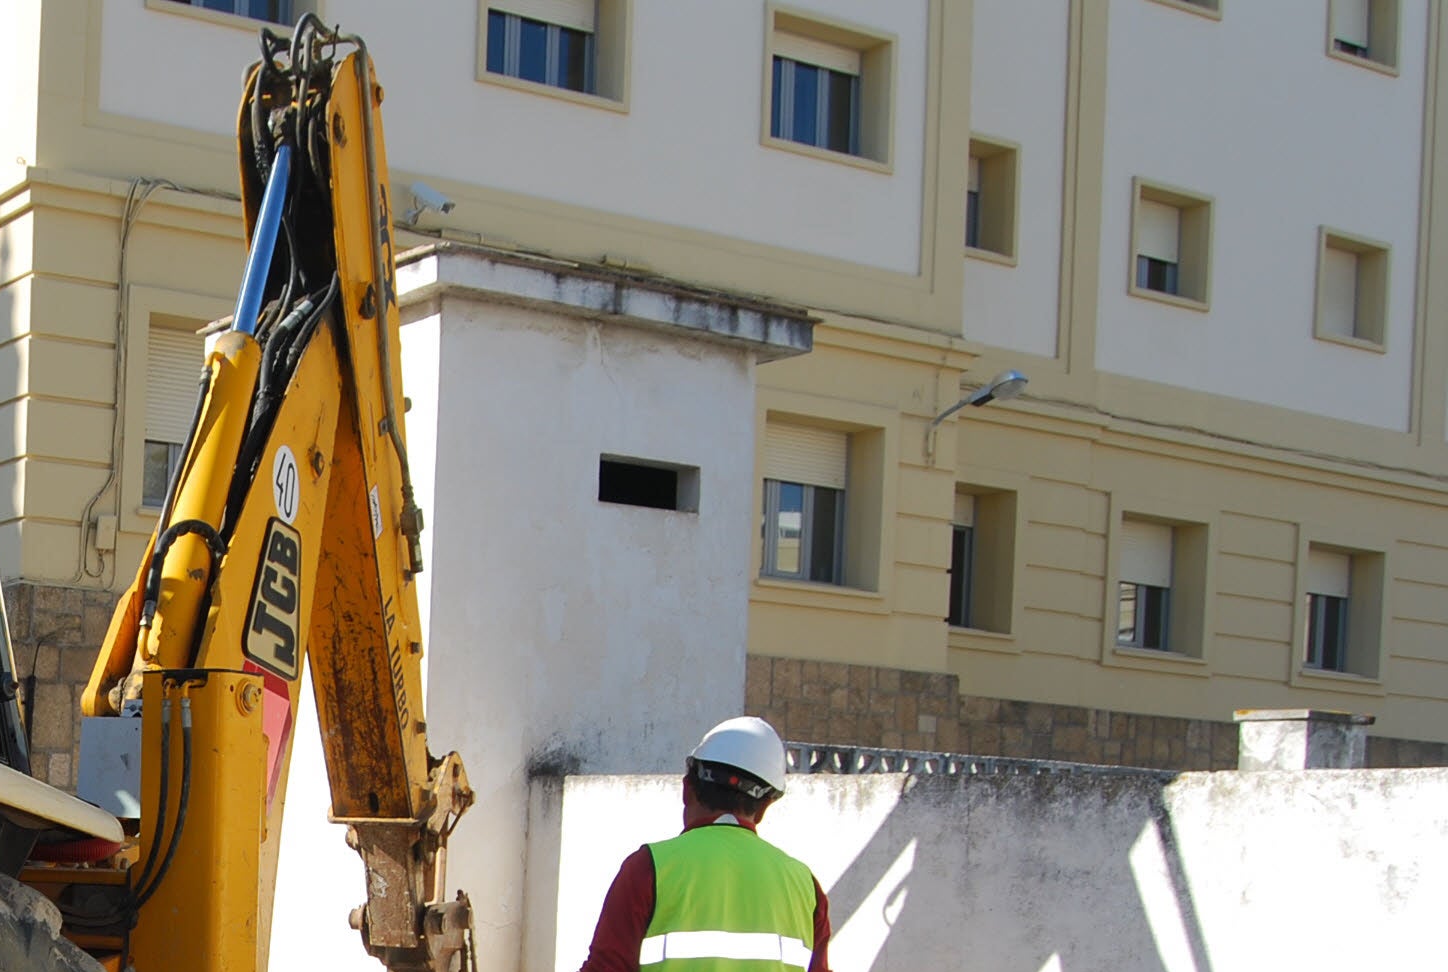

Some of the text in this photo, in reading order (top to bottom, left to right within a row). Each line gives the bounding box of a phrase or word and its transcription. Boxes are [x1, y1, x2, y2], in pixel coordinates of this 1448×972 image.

[276, 453, 296, 518] 40
[252, 530, 299, 668] JCB
[384, 595, 410, 730] LA TURBO
